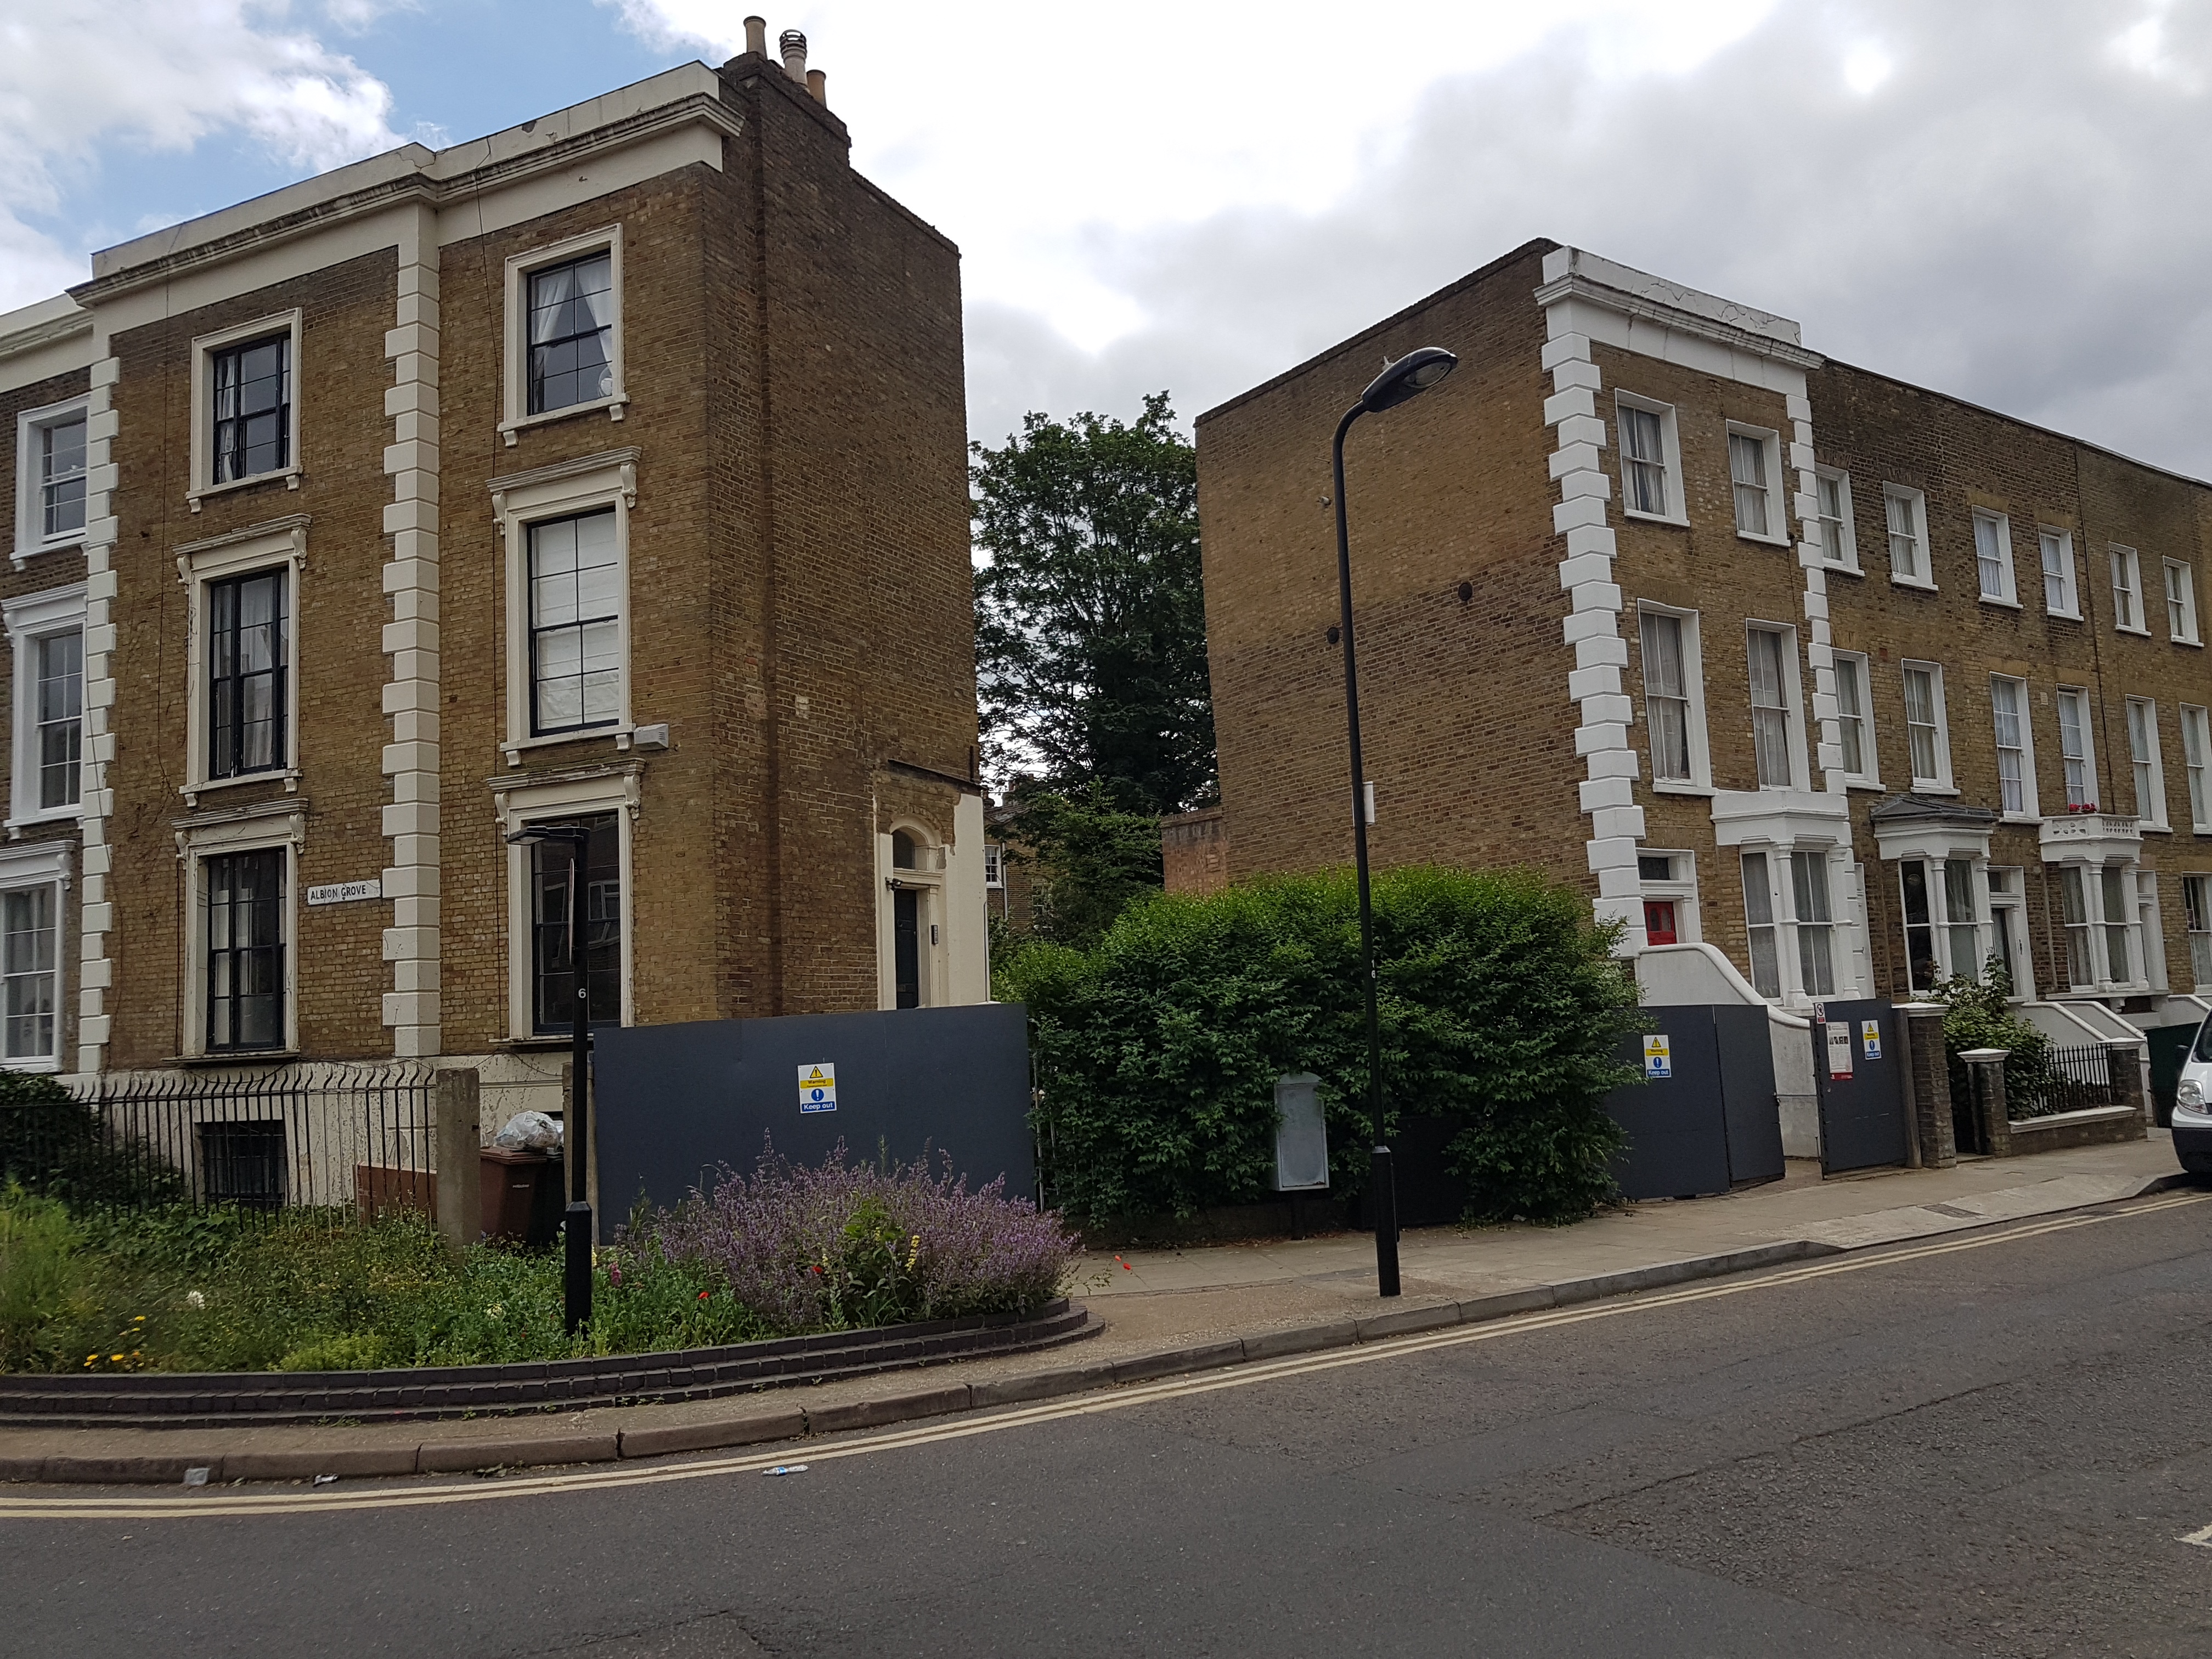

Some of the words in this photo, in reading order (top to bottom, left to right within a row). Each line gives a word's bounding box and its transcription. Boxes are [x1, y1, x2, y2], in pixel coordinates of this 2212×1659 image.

[311, 888, 337, 900] ALBION
[341, 885, 366, 896] GROVE
[579, 989, 586, 998] 6
